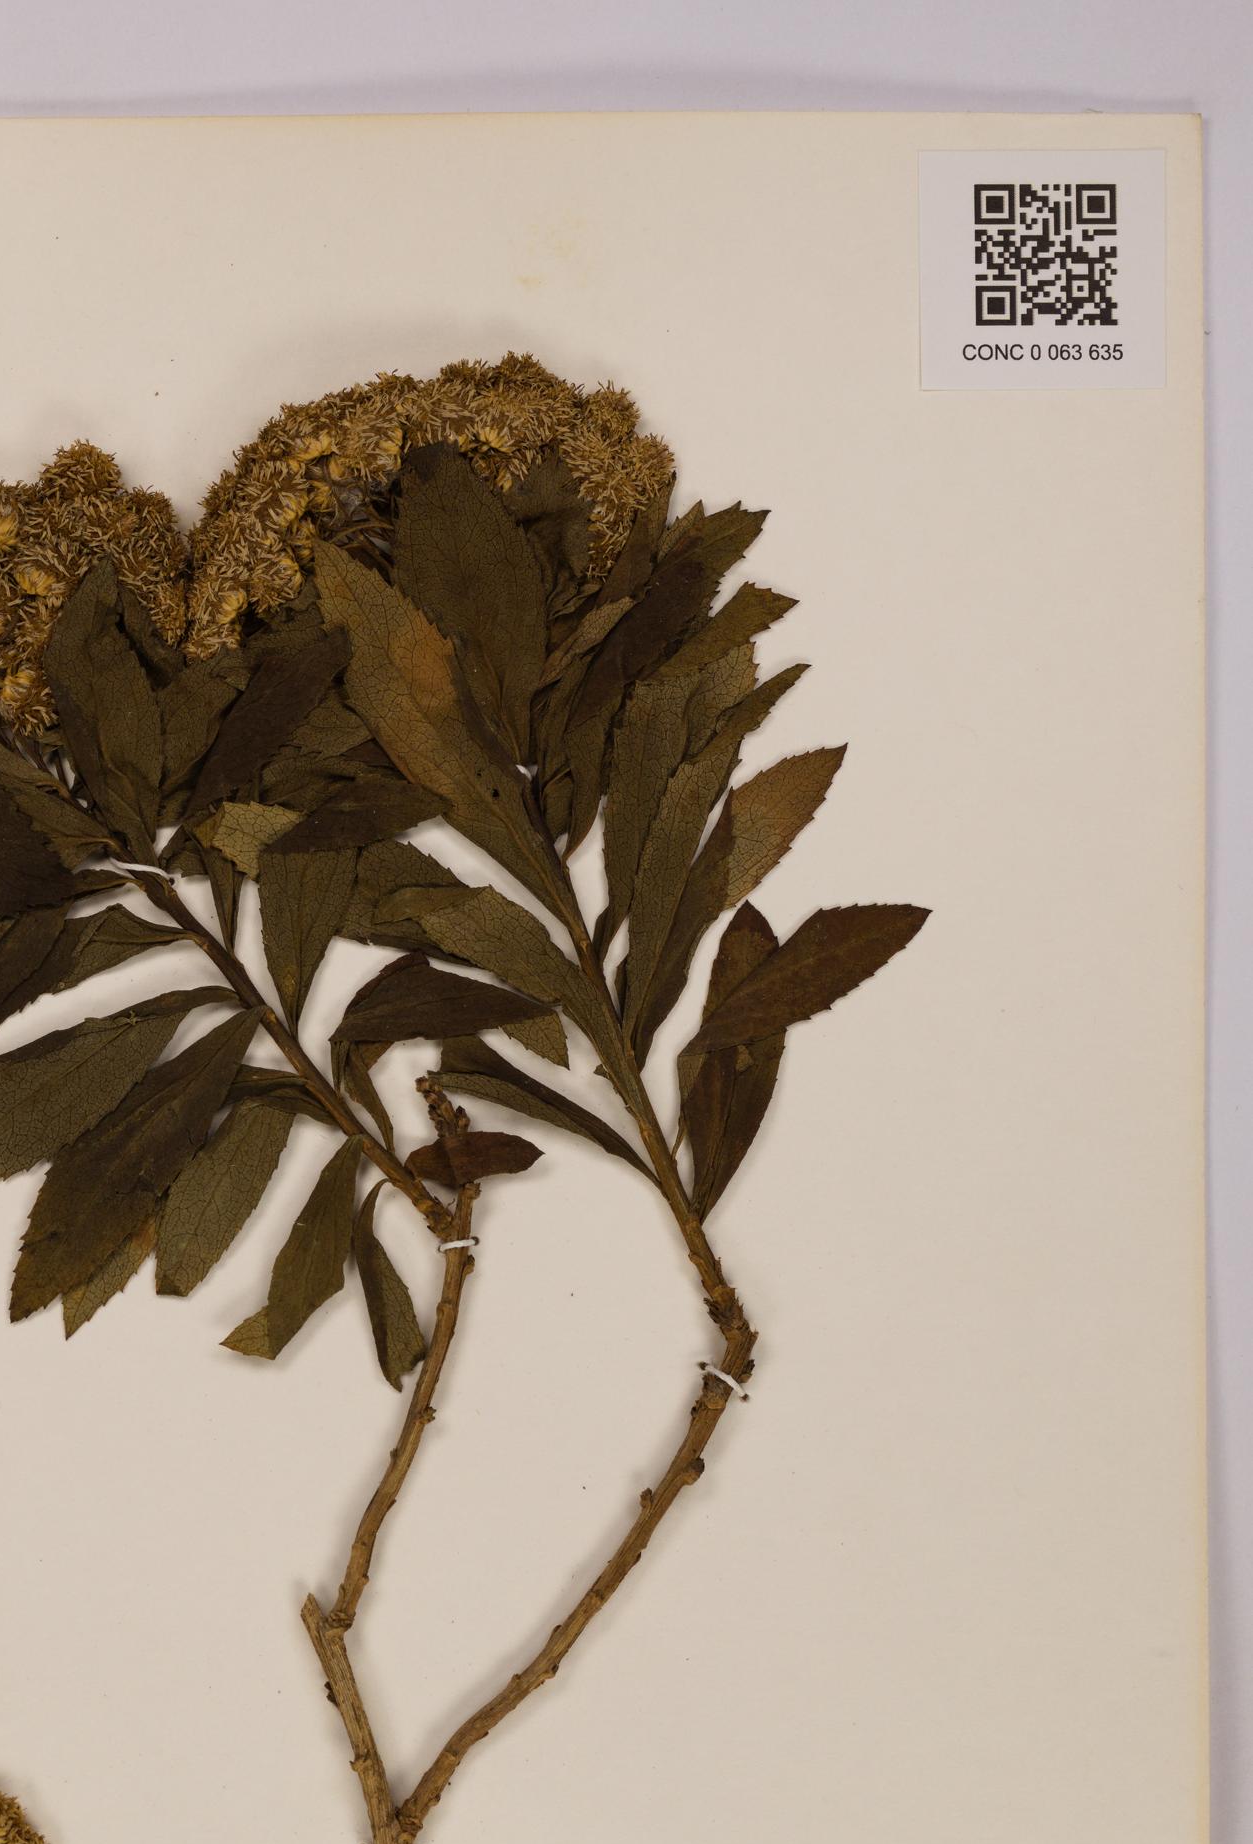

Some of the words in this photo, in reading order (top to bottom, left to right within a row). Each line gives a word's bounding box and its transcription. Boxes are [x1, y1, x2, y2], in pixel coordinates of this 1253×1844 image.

[962, 343, 1024, 361] CONC
[1030, 343, 1042, 361] 0
[1047, 343, 1083, 361] 063
[1088, 343, 1124, 361] 635
